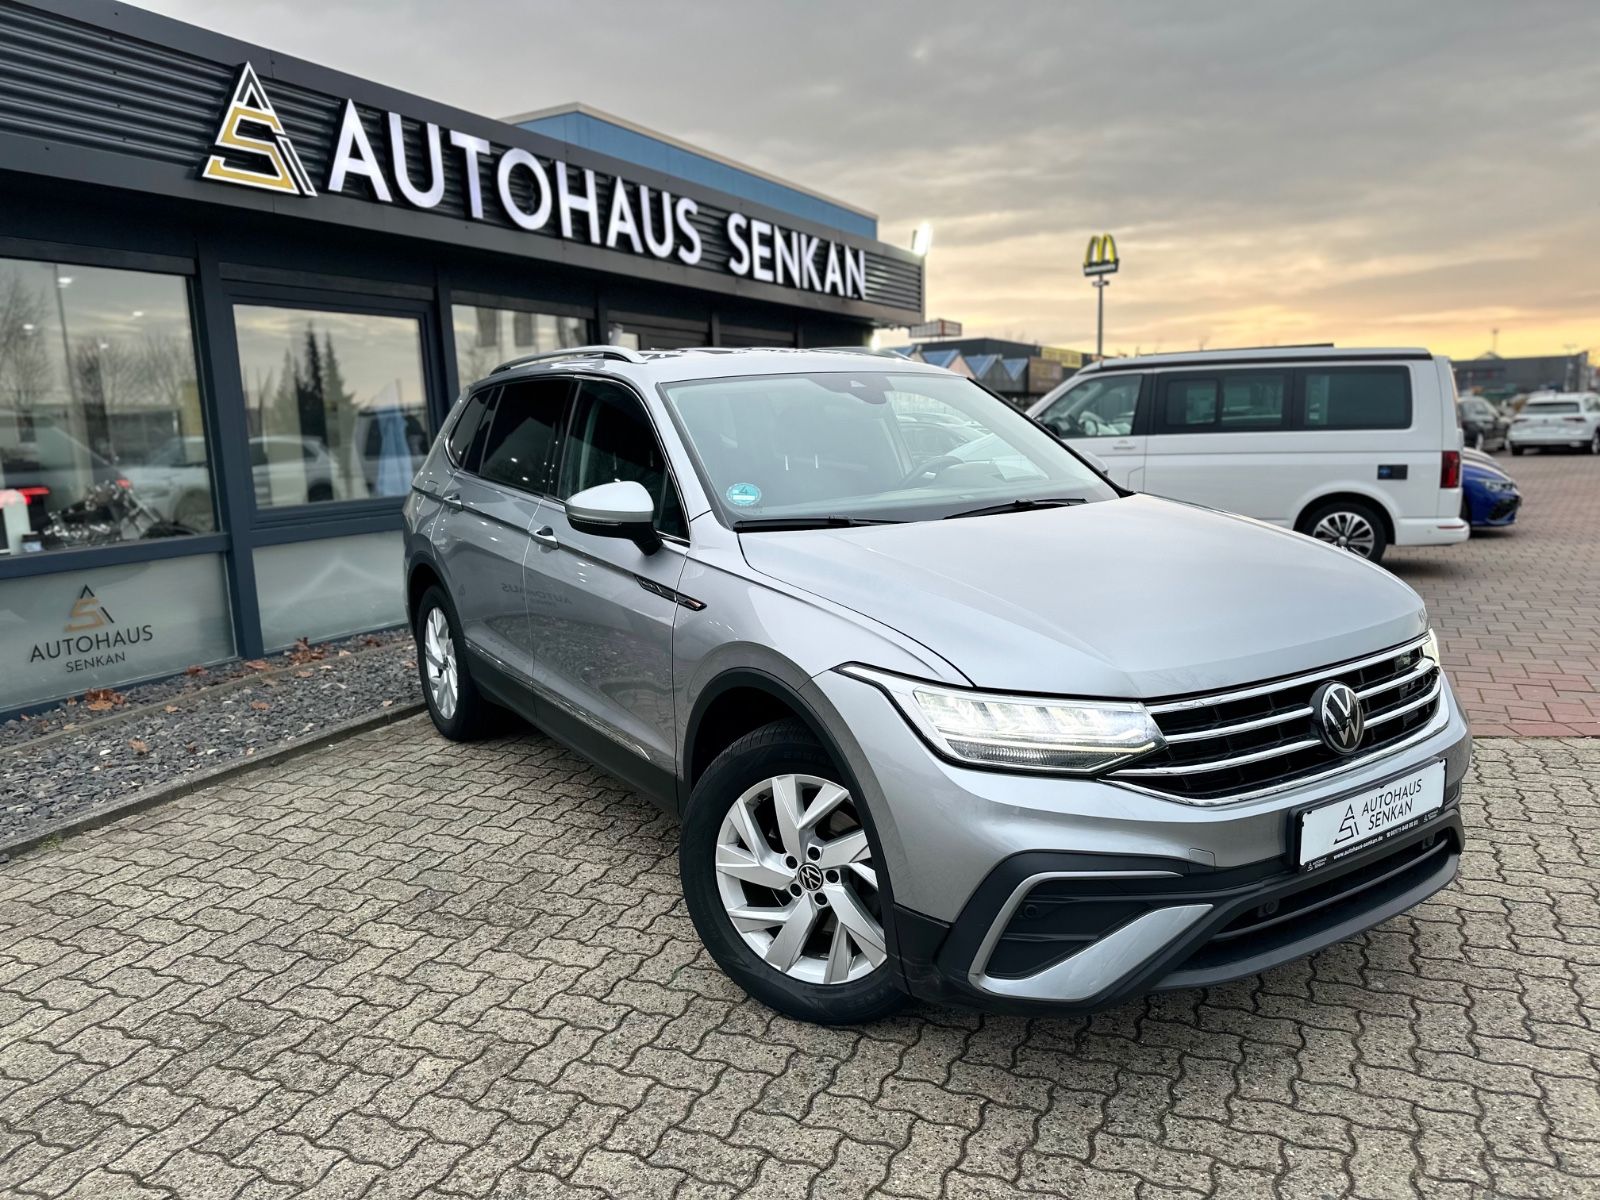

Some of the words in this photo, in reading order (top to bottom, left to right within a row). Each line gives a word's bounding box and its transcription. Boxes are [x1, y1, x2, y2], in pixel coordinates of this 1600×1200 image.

[327, 98, 702, 265] AUTOHAUS
[726, 212, 866, 300] SENKAN
[30, 625, 153, 662] AUTOHAUS
[66, 651, 126, 673] SENKAN
[1362, 778, 1422, 816] AUTOHAUS
[1368, 798, 1413, 831] SENKAN
